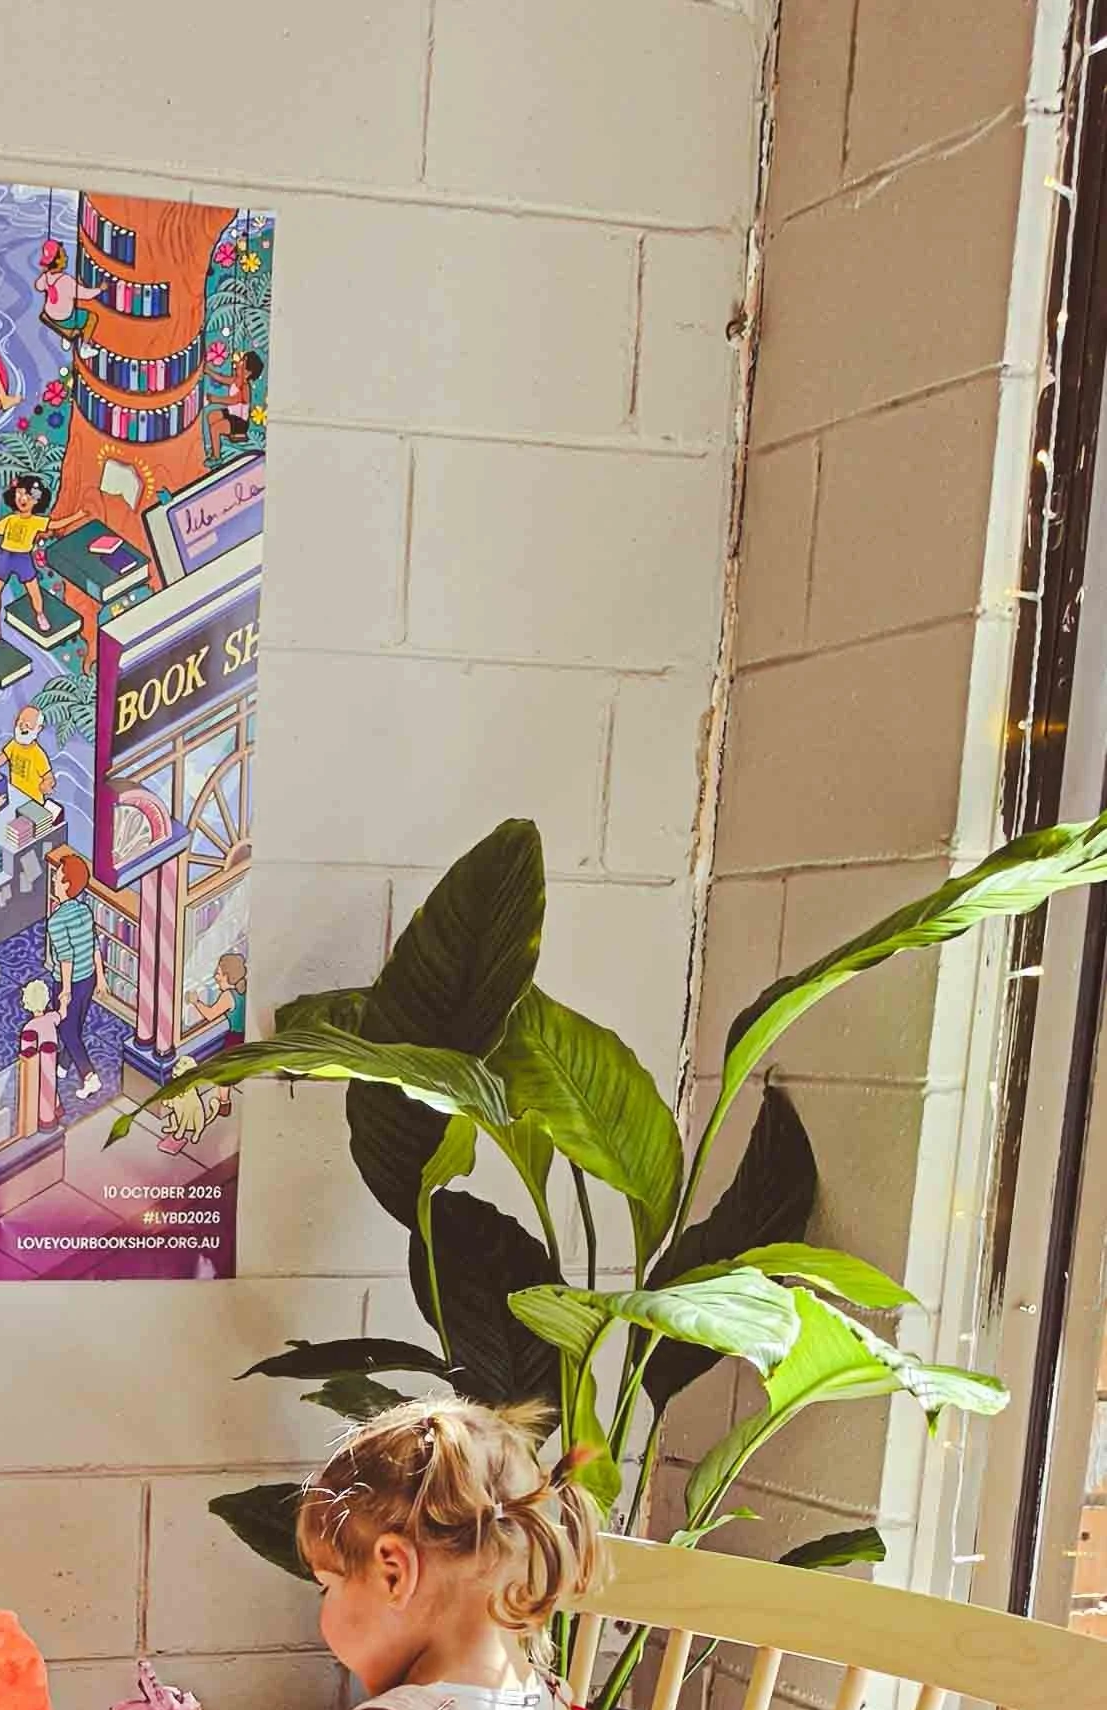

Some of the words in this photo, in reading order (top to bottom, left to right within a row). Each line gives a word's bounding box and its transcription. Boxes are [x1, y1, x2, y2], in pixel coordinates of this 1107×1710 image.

[116, 645, 210, 736] BOOK
[103, 1186, 117, 1198] 10
[120, 1186, 185, 1199] OCTOBER
[188, 1186, 222, 1199] 2026
[142, 1211, 220, 1224] #LYBD2026
[17, 1236, 220, 1250] LOVEYOURBOOKSHOP.ORG.AU
